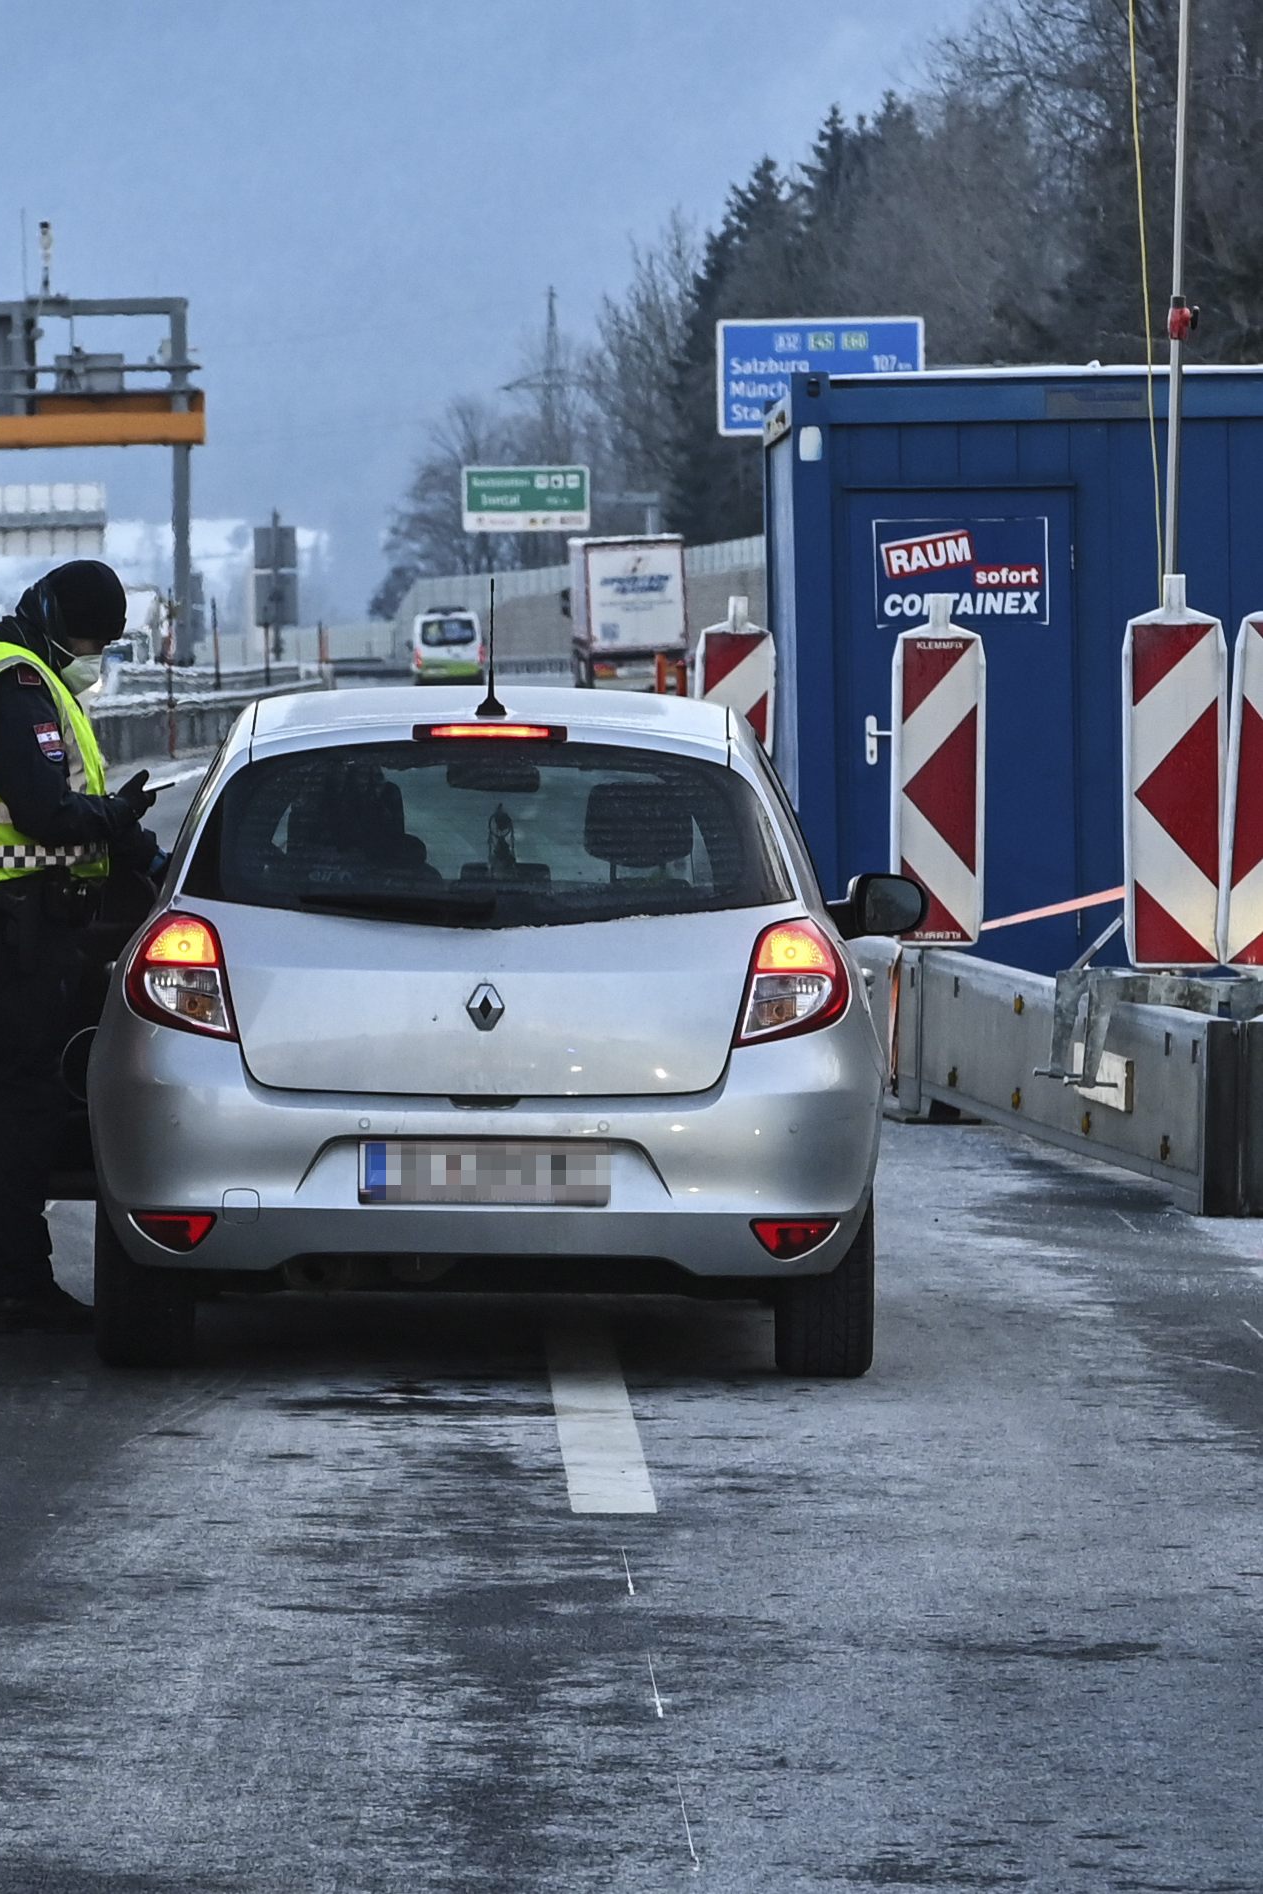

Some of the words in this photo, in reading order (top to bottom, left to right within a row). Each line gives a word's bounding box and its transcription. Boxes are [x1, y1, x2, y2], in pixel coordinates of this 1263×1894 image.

[730, 357, 810, 375] Salzburg
[730, 380, 788, 398] Münch
[731, 404, 764, 421] Sta
[889, 537, 972, 575] RAUM
[975, 567, 1039, 585] sofort
[916, 641, 964, 650] KLEMMFIX
